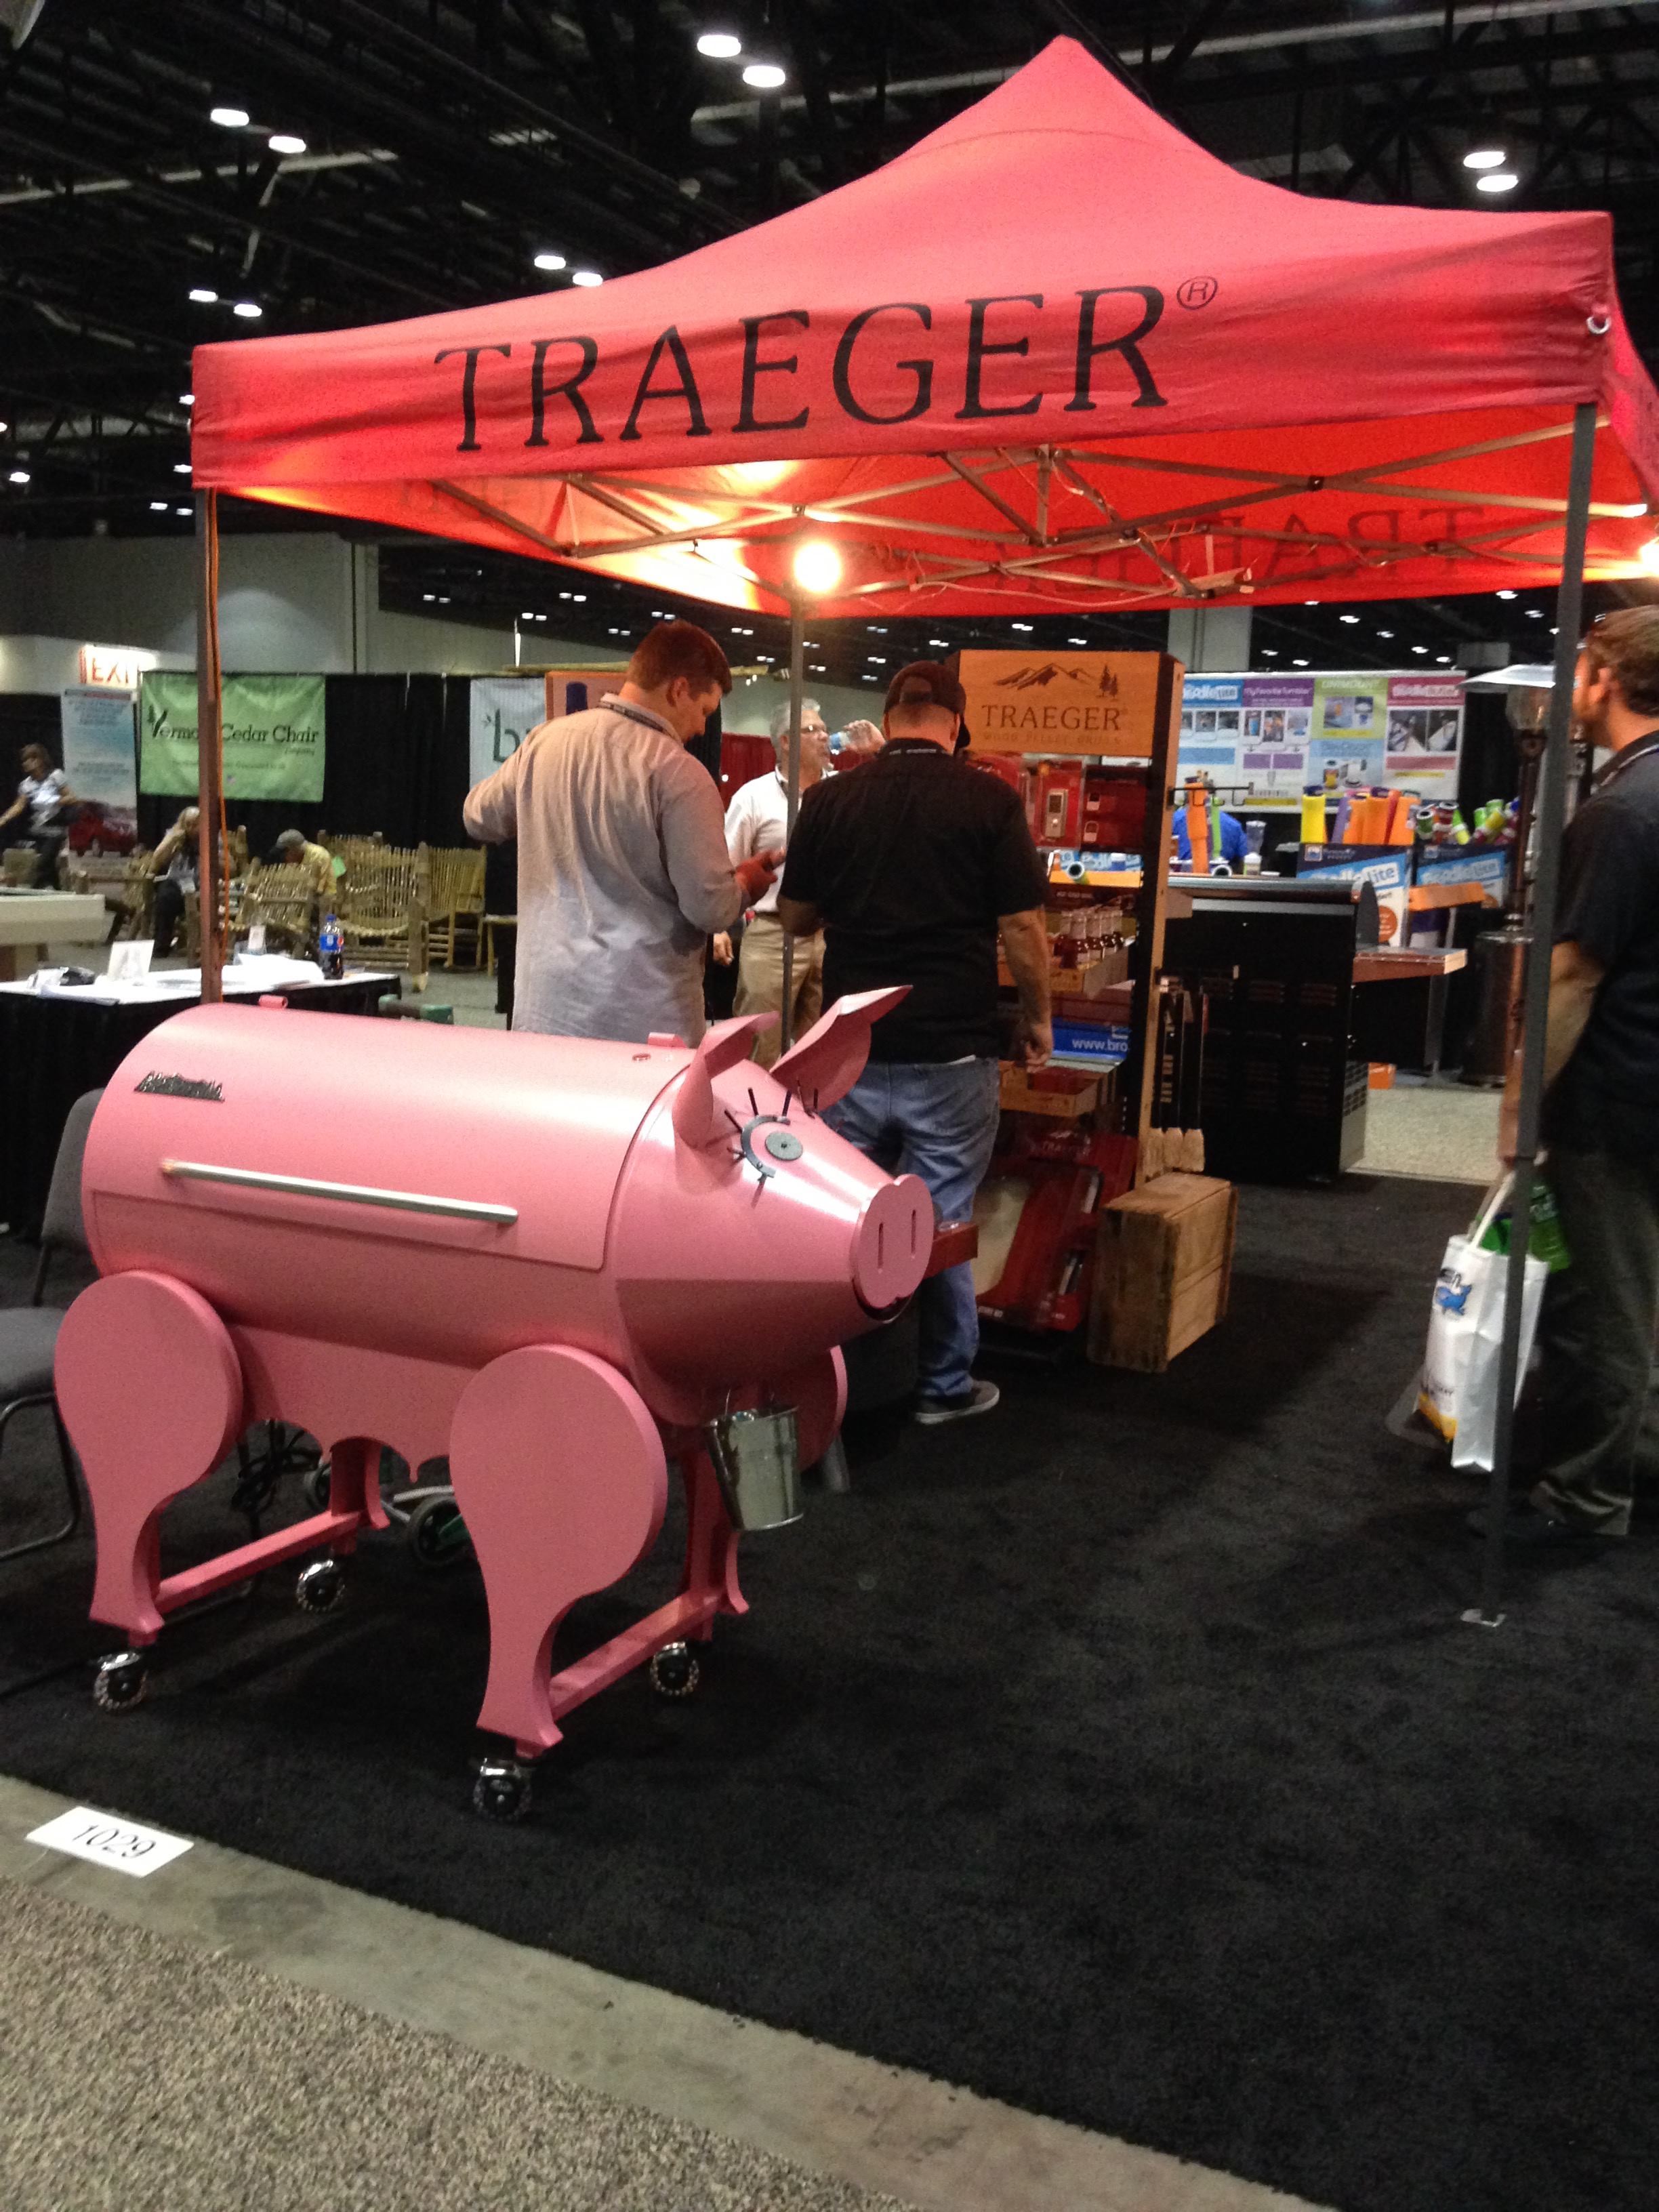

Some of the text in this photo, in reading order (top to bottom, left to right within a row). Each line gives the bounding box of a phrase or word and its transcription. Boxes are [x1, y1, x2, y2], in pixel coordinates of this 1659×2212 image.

[434, 285, 1168, 452] TRAEGER
[92, 657, 129, 684] EXI
[982, 705, 1121, 731] TRAEGER
[222, 723, 268, 741] Cedar
[273, 724, 319, 743] Chair
[1071, 1038, 1128, 1052] www.bro
[73, 1824, 157, 1858] 1029
